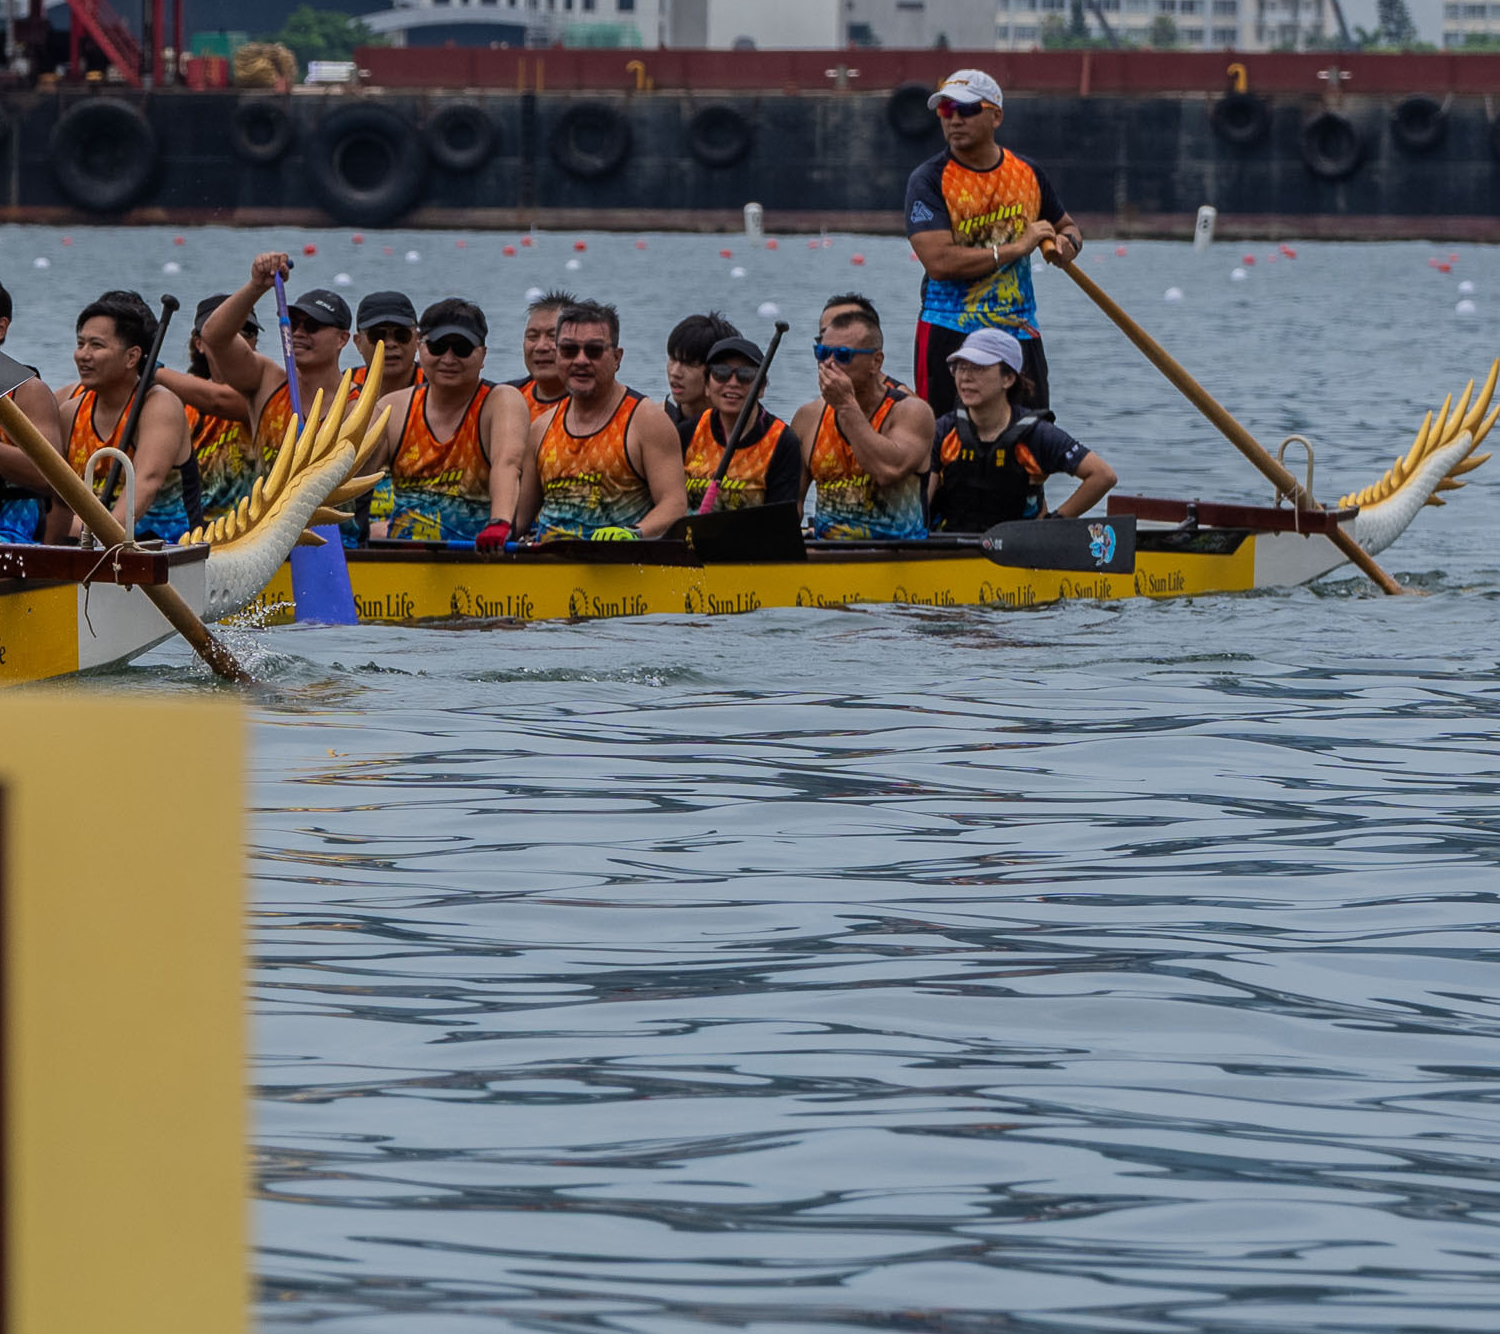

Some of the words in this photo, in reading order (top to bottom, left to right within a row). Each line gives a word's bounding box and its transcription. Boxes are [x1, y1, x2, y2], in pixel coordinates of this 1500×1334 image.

[1074, 581, 1094, 599] Sun
[1095, 577, 1111, 598] Life
[1148, 575, 1167, 593] Sun
[1169, 571, 1185, 592] Life
[355, 594, 382, 618] Sun
[386, 593, 414, 618] Life
[592, 595, 621, 615] Sun
[623, 594, 648, 615] Life
[707, 593, 735, 614] Sun
[737, 591, 762, 612] Life
[995, 587, 1019, 605] Sun
[1018, 584, 1036, 605] Life
[475, 594, 504, 619] Sun
[506, 593, 534, 619] Life
